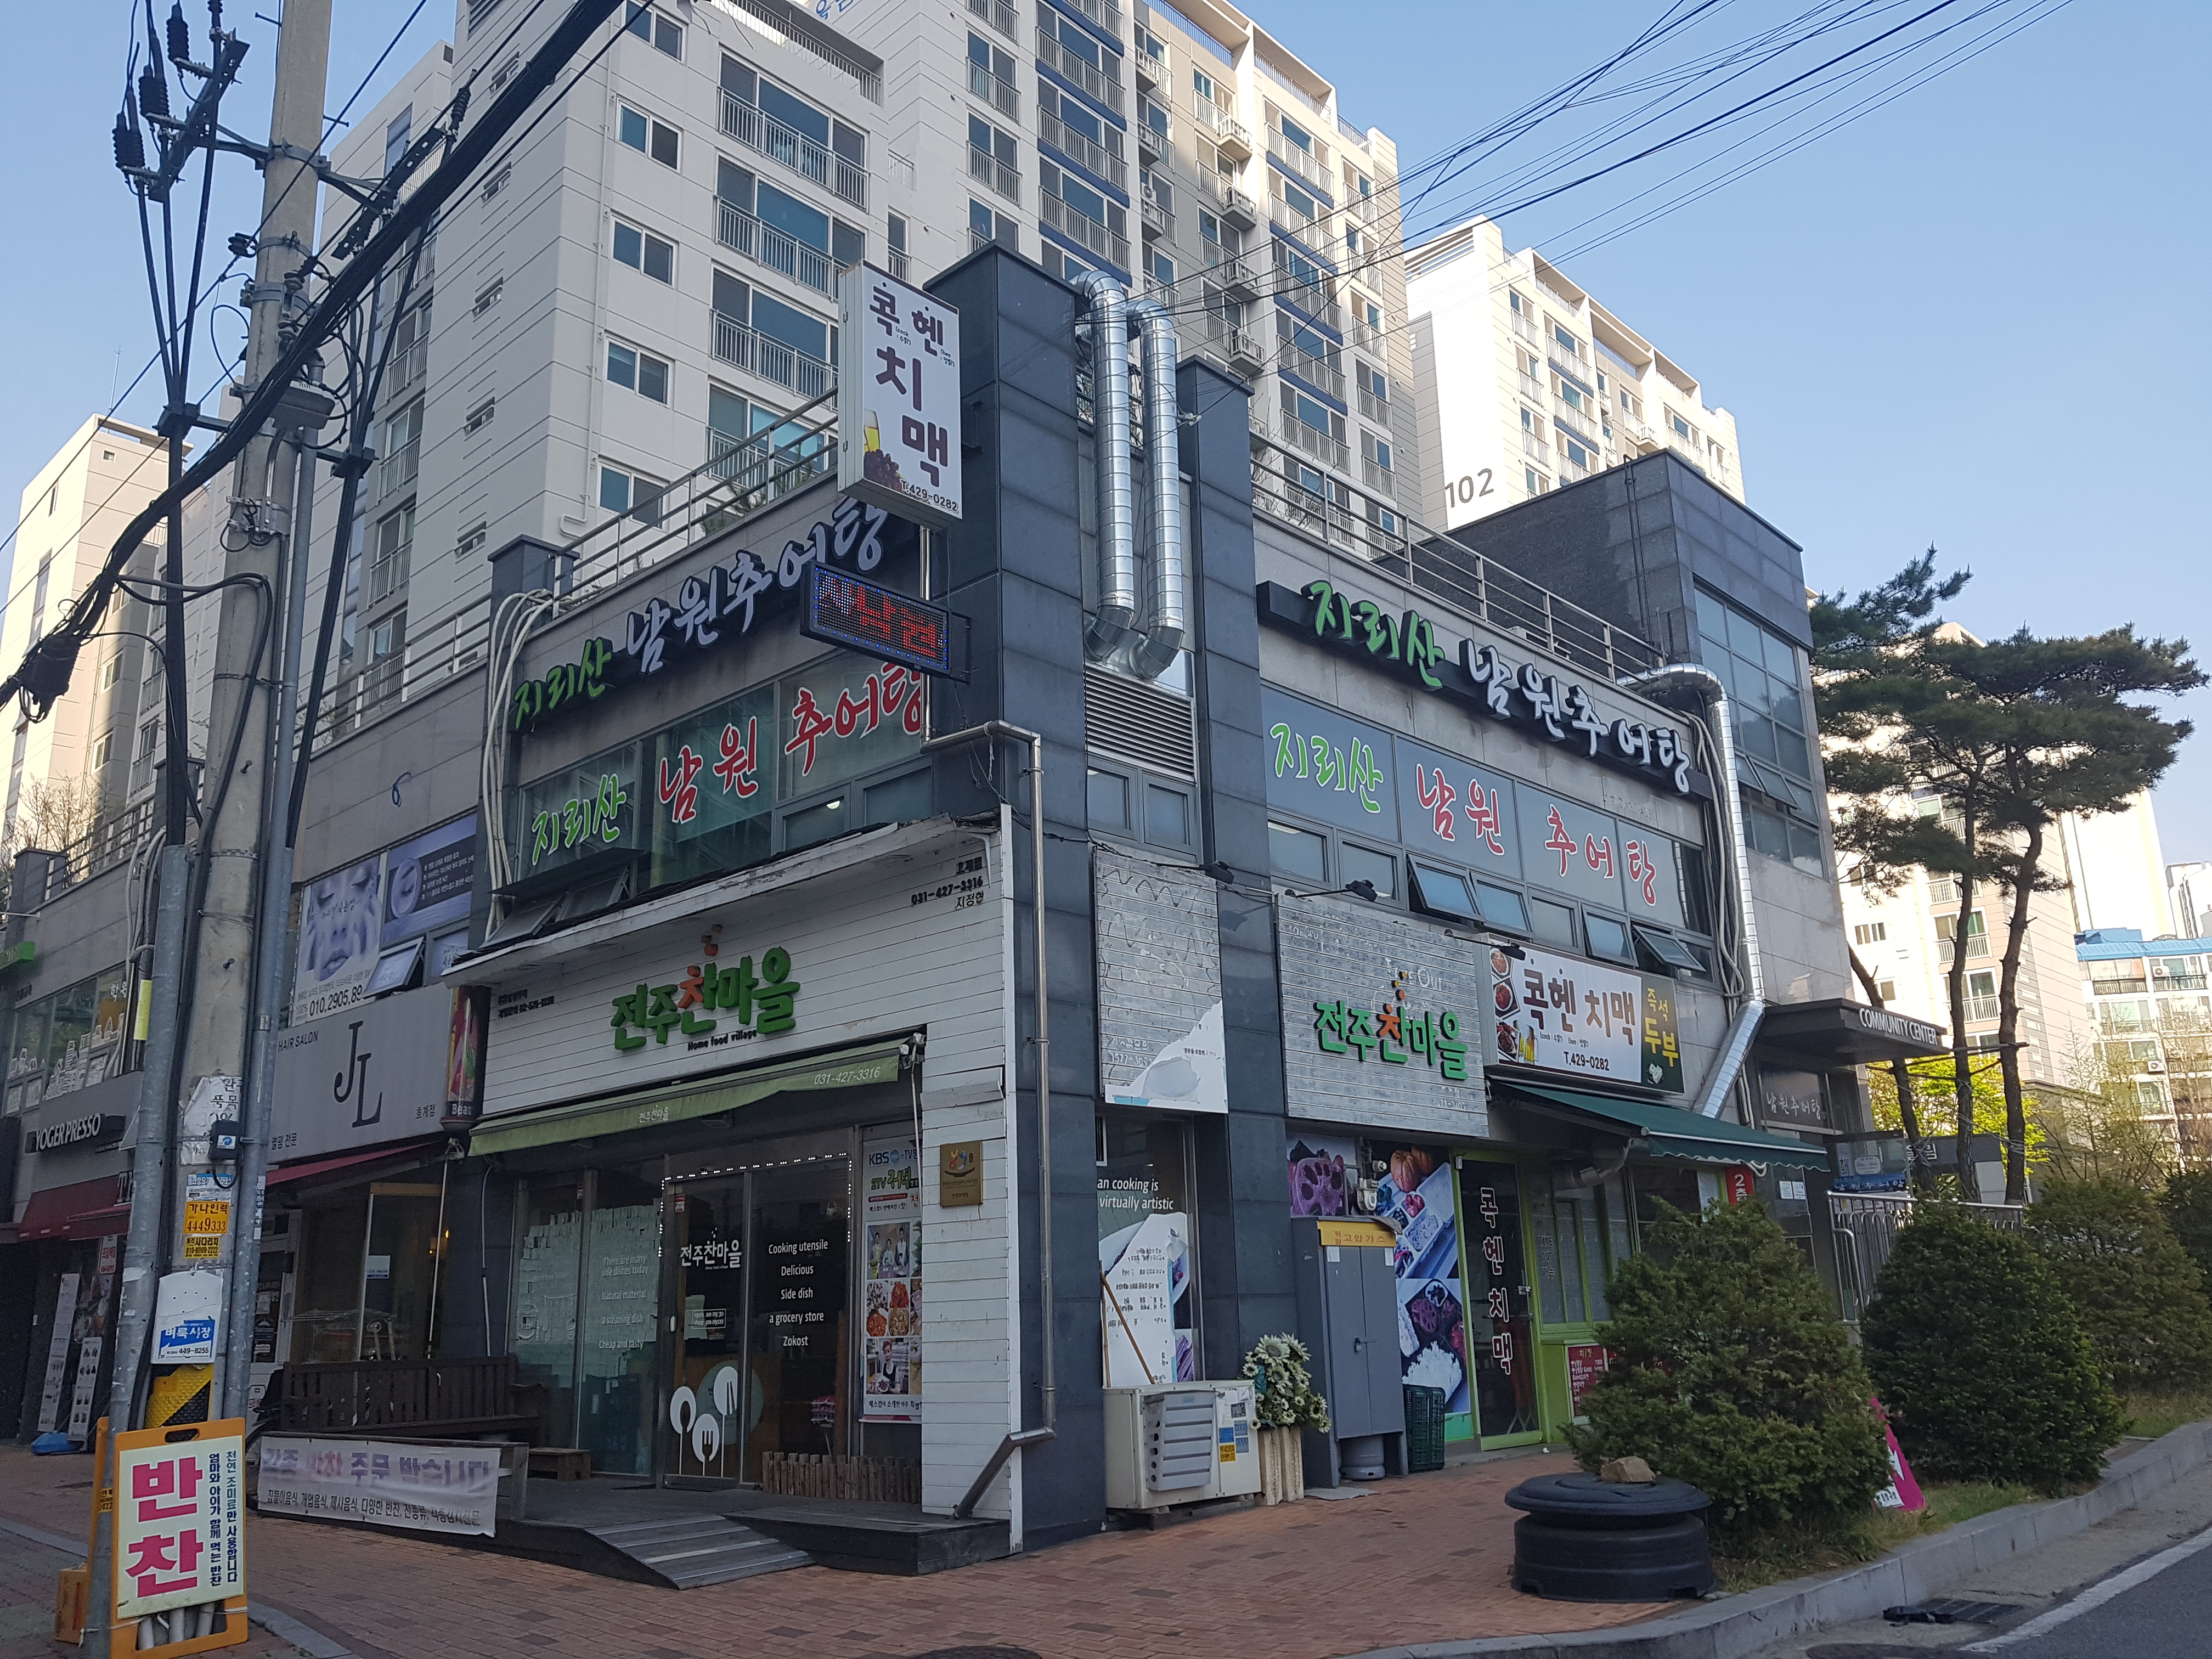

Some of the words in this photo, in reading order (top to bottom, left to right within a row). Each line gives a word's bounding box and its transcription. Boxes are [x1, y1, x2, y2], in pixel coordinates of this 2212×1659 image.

[900, 479, 959, 513] T.429-0282
[1444, 468, 1494, 508] 102
[1306, 579, 1446, 689] 지리산
[514, 637, 612, 732] 지리산
[532, 773, 626, 866] 지리산
[658, 716, 759, 823] 남원
[1269, 723, 1384, 813] 지리산
[1417, 764, 1505, 856] 남원
[1545, 804, 1657, 906] 추어탕
[911, 876, 984, 904] 031-427-3316
[956, 890, 984, 908] 지정현
[611, 947, 801, 1051] 전주찬마을
[1646, 988, 1668, 1022] 즉석
[1859, 1007, 1909, 1038] COMMUNITY
[1909, 1020, 1938, 1046] CENTER
[278, 1036, 294, 1052] HAIR
[295, 1030, 318, 1047] SALON
[687, 1038, 708, 1051] Home
[710, 1032, 729, 1047] food
[730, 1028, 758, 1046] village
[1314, 1000, 1469, 1080] 전주찬마을
[1644, 1017, 1679, 1068] 두부
[1564, 1051, 1610, 1071] T.429-0282
[334, 1020, 382, 1128] JL
[813, 1066, 881, 1086] 031-427-3316
[415, 1104, 436, 1119] 호계점
[638, 1105, 669, 1125] 전주찬마을
[285, 1132, 297, 1146] 전문
[869, 1152, 889, 1166] KBS
[1111, 1176, 1148, 1194] cooking
[1150, 1178, 1159, 1192] is
[189, 1204, 228, 1214] 가나인력
[1099, 1195, 1139, 1211] virtually
[1142, 1197, 1174, 1210] artistic
[768, 1242, 798, 1257] Cooking
[799, 1239, 829, 1252] utensile
[1343, 1234, 1385, 1243] 고압가스
[1538, 1236, 1554, 1248] TAKE
[603, 1257, 618, 1266] There
[630, 1256, 646, 1265] many
[680, 1239, 742, 1268] 전주찬마을
[1541, 1251, 1553, 1263] OUT
[601, 1267, 613, 1277] side
[613, 1266, 631, 1276] dishes
[632, 1265, 648, 1276] today
[781, 1263, 814, 1277] Delicious
[601, 1290, 622, 1300] Natural
[623, 1290, 646, 1299] material
[781, 1288, 796, 1300] Side
[798, 1286, 813, 1299] dish
[631, 1314, 643, 1323] dish
[769, 1314, 774, 1323] a
[775, 1313, 803, 1325] grocery
[804, 1311, 824, 1323] store
[165, 1327, 211, 1339] 벼룩시장
[782, 1335, 809, 1347] Zokost
[599, 1339, 616, 1350] Cheap
[617, 1339, 628, 1348] and
[629, 1340, 644, 1351] tasty
[209, 1453, 220, 1483] 엄마와
[226, 1450, 236, 1474] 천연
[351, 1452, 390, 1486] 주문
[209, 1486, 220, 1515] 아이가
[226, 1476, 236, 1523] 조미료만
[362, 1498, 382, 1515] 다양한
[385, 1501, 402, 1517] 반찬,
[125, 1456, 204, 1598] 반찬
[210, 1519, 221, 1539] 함께
[210, 1542, 221, 1563] 먹는
[227, 1525, 238, 1583] 사용합니다
[210, 1565, 222, 1587] 반찬
